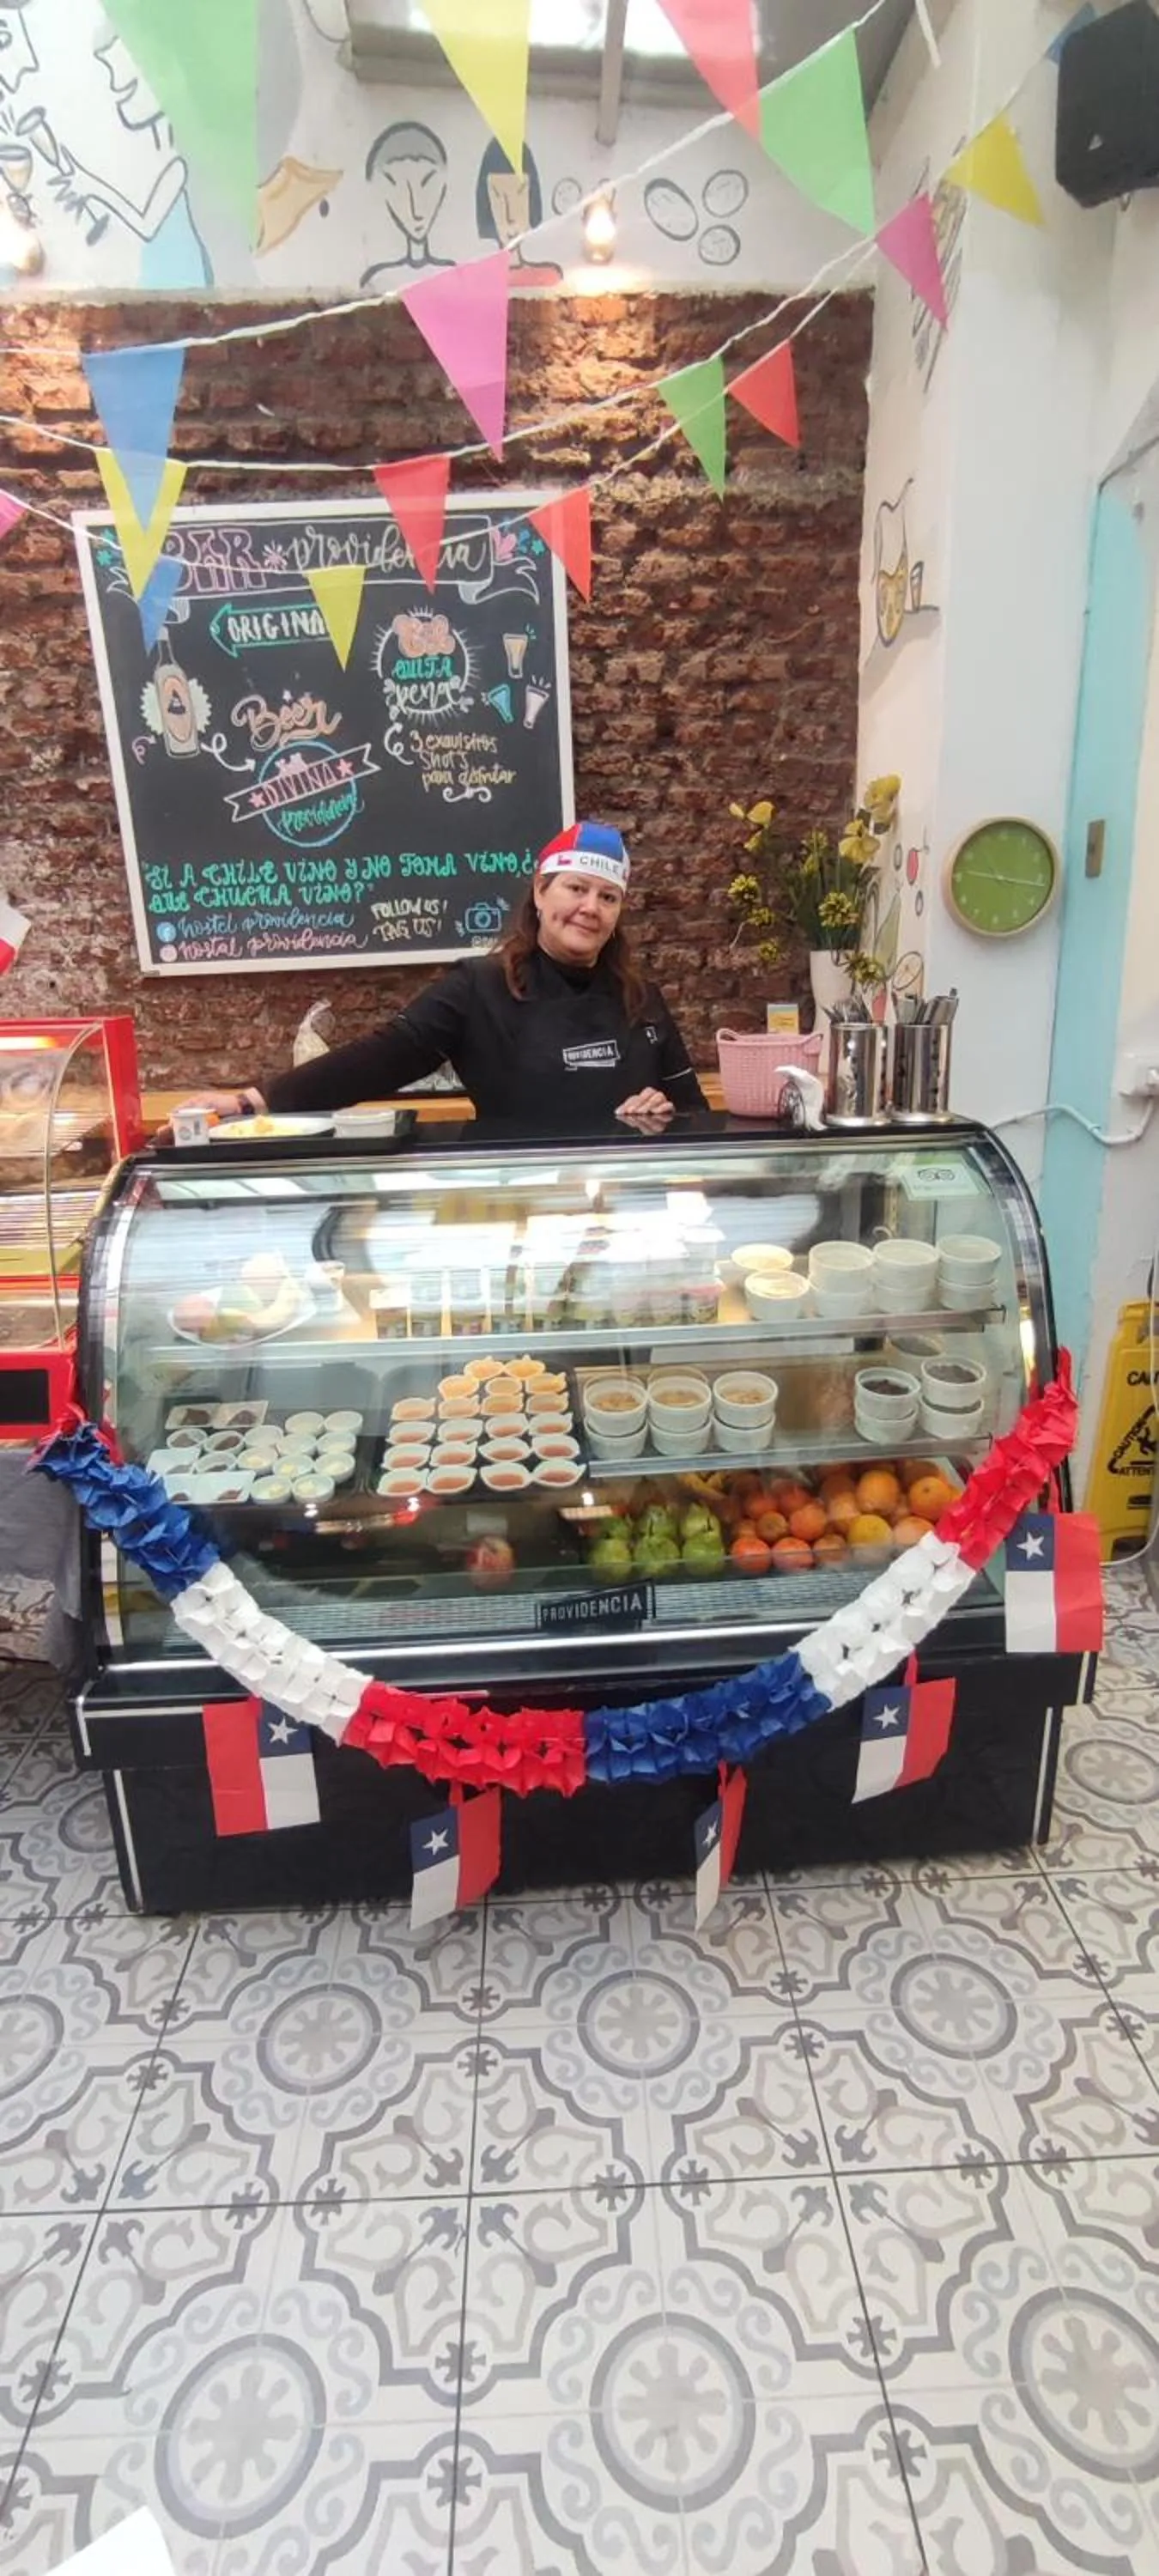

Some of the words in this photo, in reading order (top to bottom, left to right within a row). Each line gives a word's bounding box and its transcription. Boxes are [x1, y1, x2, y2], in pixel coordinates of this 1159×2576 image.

[287, 525, 485, 574] provideia
[228, 609, 325, 643] ORIGINA
[231, 694, 343, 751] Beer
[410, 730, 423, 752] 3
[262, 761, 337, 809] DIVINA
[179, 862, 197, 888] A
[202, 859, 279, 885] CHILE
[283, 859, 337, 884] VINO
[344, 857, 358, 880] Y
[361, 853, 391, 880] NO
[399, 852, 457, 878] TOMA
[580, 856, 618, 874] CHILE
[193, 884, 293, 908] CHUCHA
[372, 920, 412, 942] TAG
[543, 1592, 643, 1622] PROVIDENCIA
